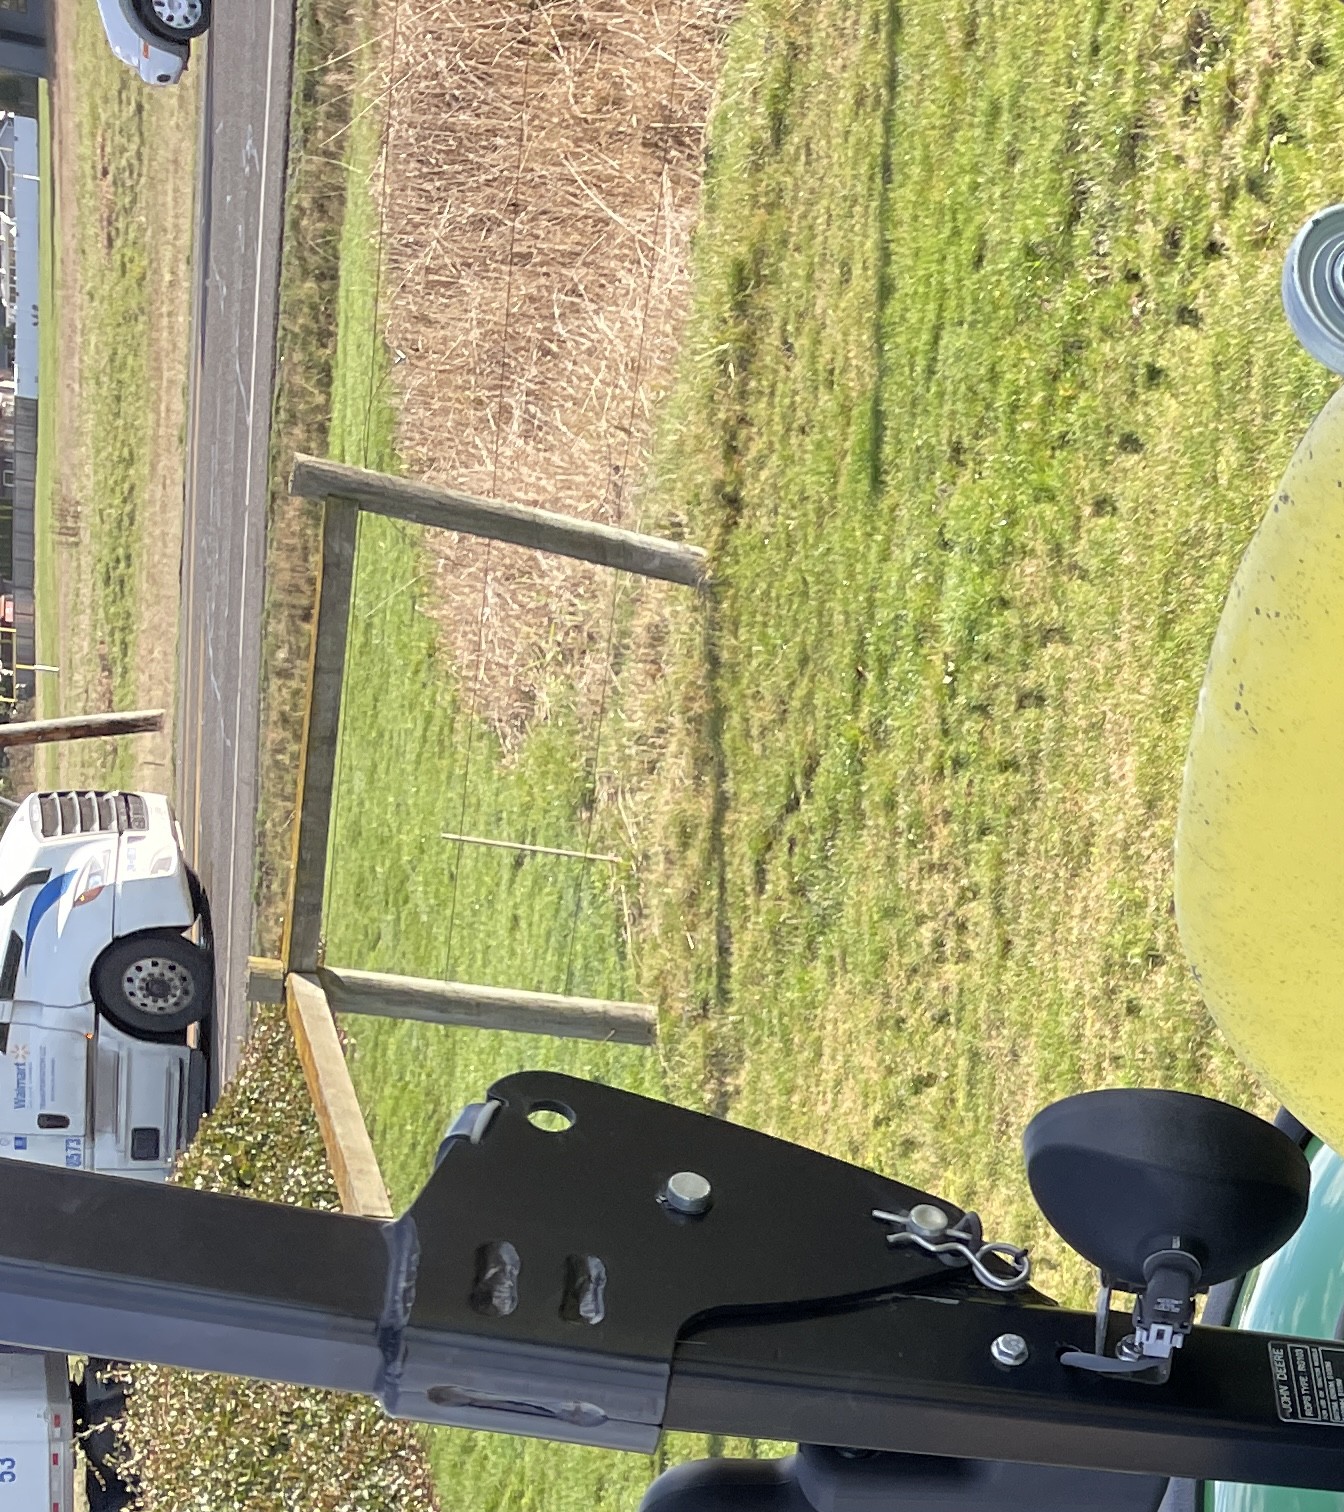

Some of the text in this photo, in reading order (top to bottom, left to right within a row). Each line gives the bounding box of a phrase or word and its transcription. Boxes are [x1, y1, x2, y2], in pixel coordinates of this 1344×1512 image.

[13, 1062, 26, 1110] Walmart
[1272, 1348, 1292, 1413] JOHN DEERE
[0, 1458, 16, 1483] 53
